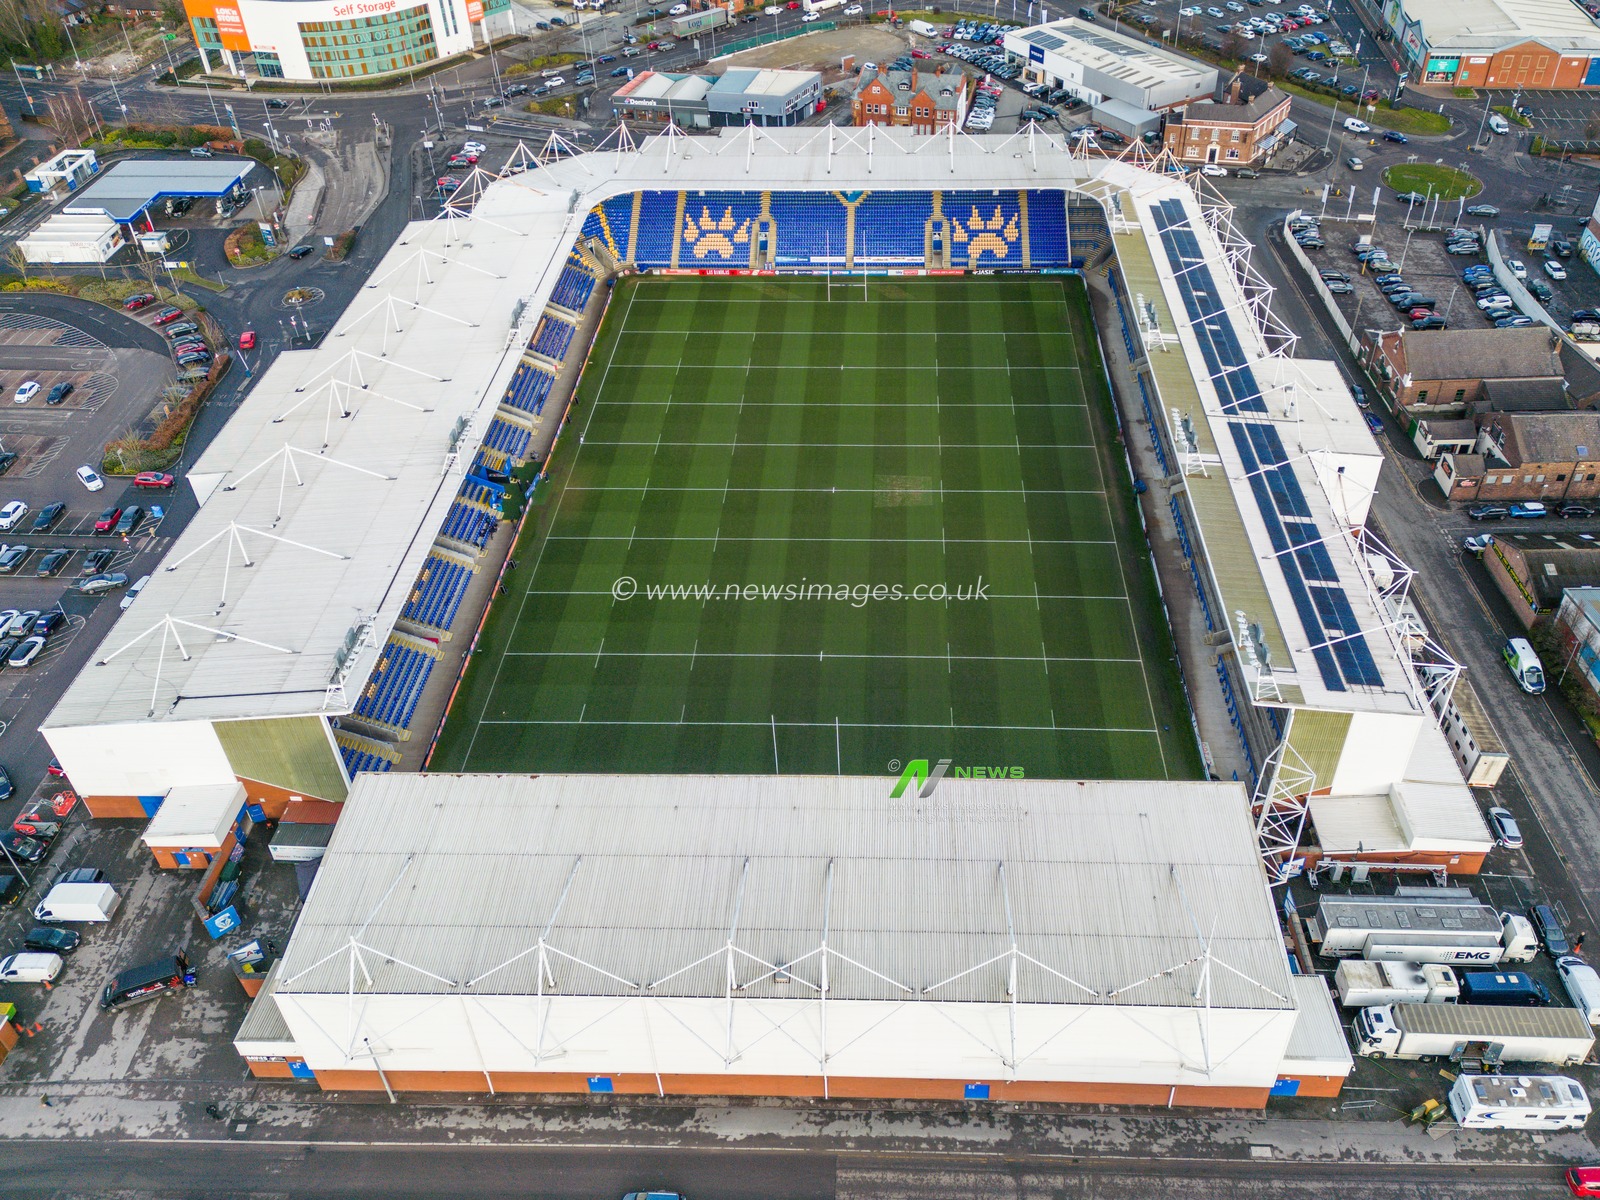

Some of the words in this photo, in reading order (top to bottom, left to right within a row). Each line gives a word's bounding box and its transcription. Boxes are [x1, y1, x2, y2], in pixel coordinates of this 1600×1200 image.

[333, 4, 354, 16] Self
[357, 0, 396, 14] Storage
[349, 31, 373, 44] NOW
[374, 27, 400, 41] OPEN
[629, 98, 657, 106] Domino's
[1454, 951, 1491, 960] EMG
